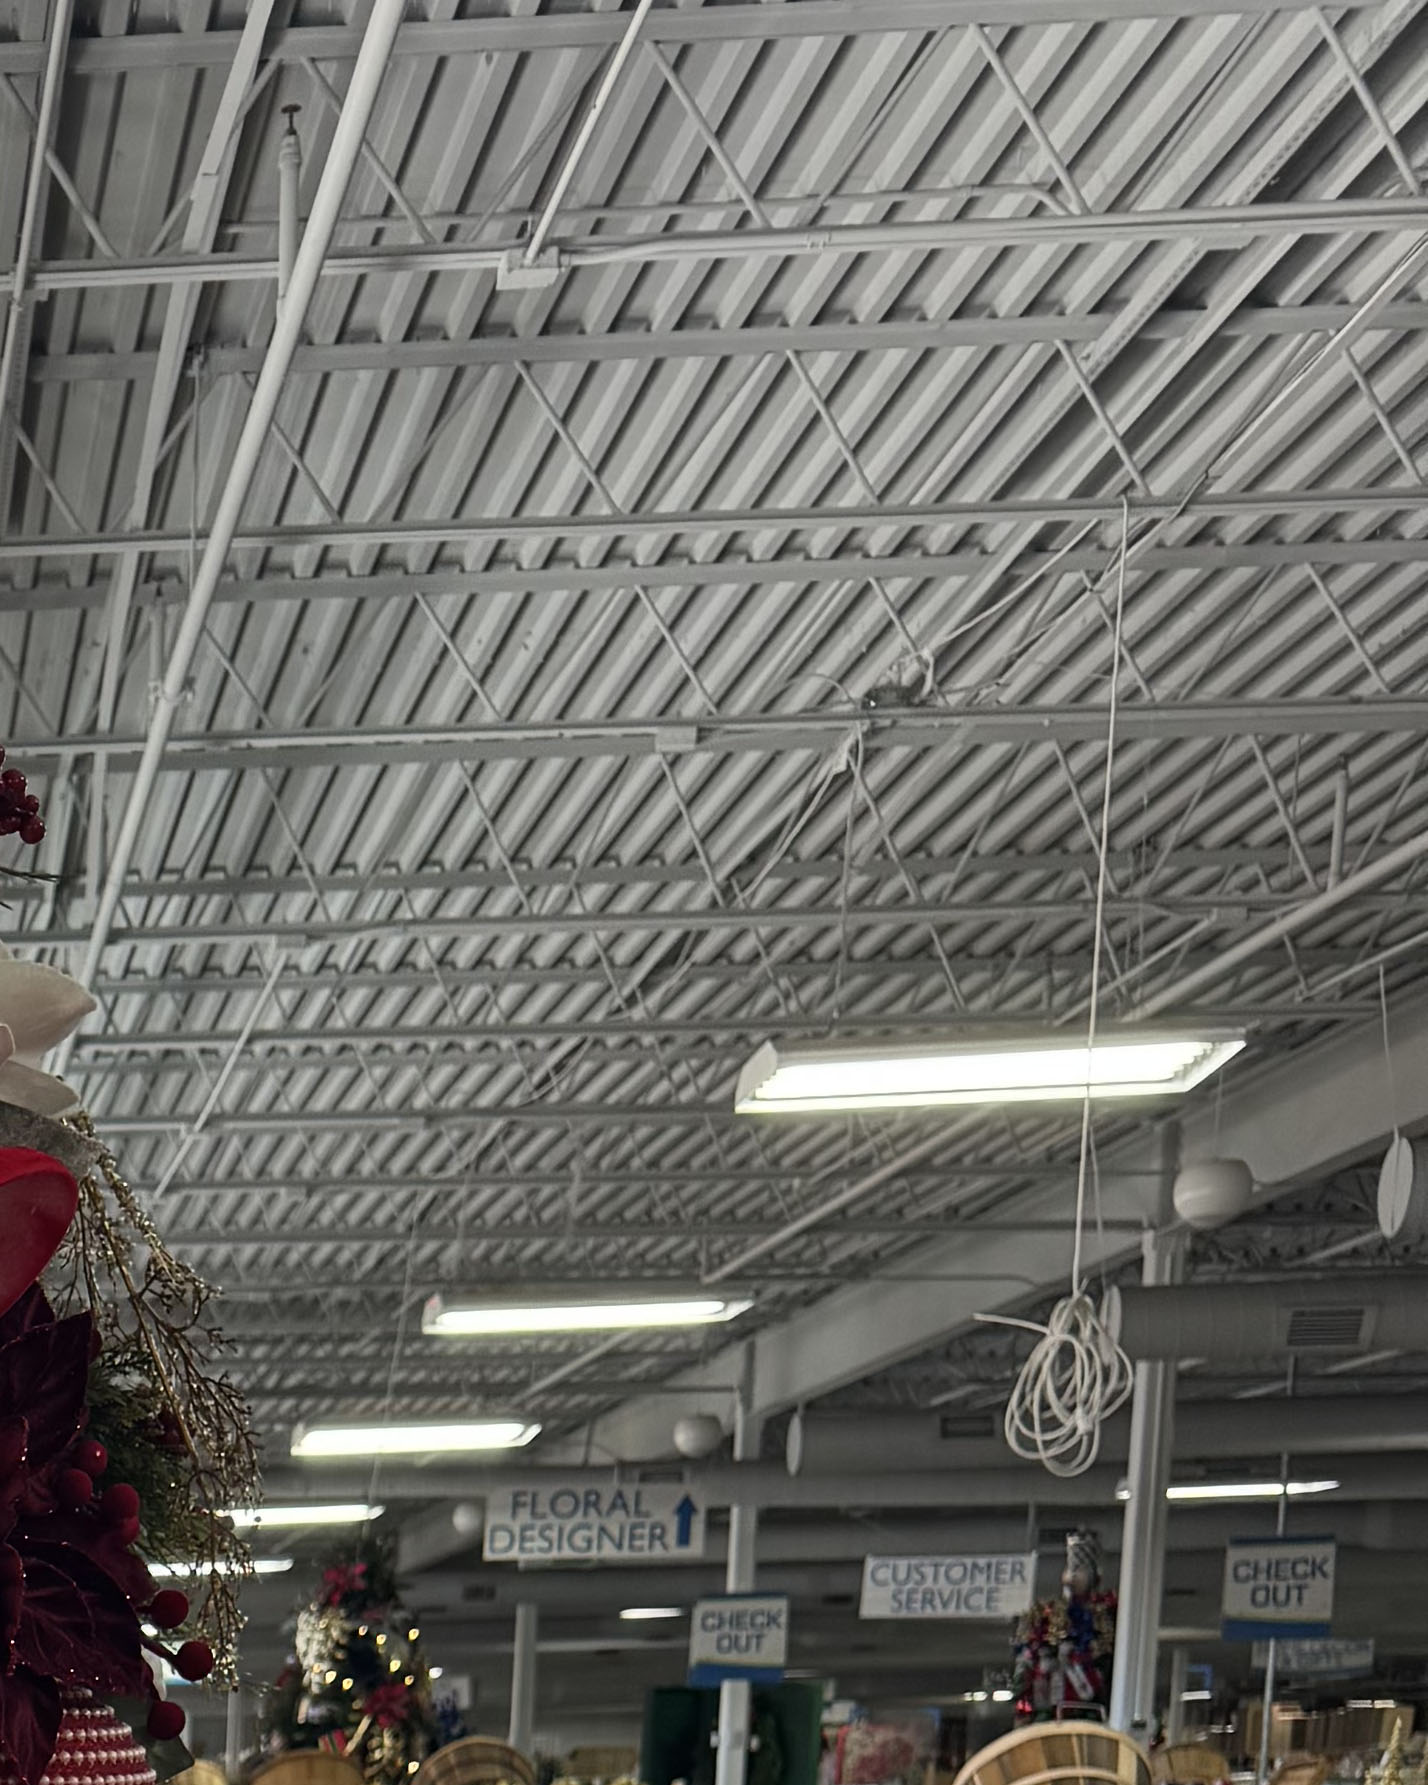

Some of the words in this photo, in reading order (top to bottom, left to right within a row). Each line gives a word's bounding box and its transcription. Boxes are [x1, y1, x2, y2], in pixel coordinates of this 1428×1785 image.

[510, 1489, 651, 1521] FLORAL
[489, 1522, 669, 1554] DESIGNER
[870, 1560, 1027, 1587] CUSTOMER
[1232, 1555, 1330, 1584] CHECK
[890, 1586, 1002, 1614] SERVICE
[1251, 1583, 1308, 1609] OUT
[700, 1608, 783, 1633] CHECK
[715, 1632, 765, 1655] OUT
